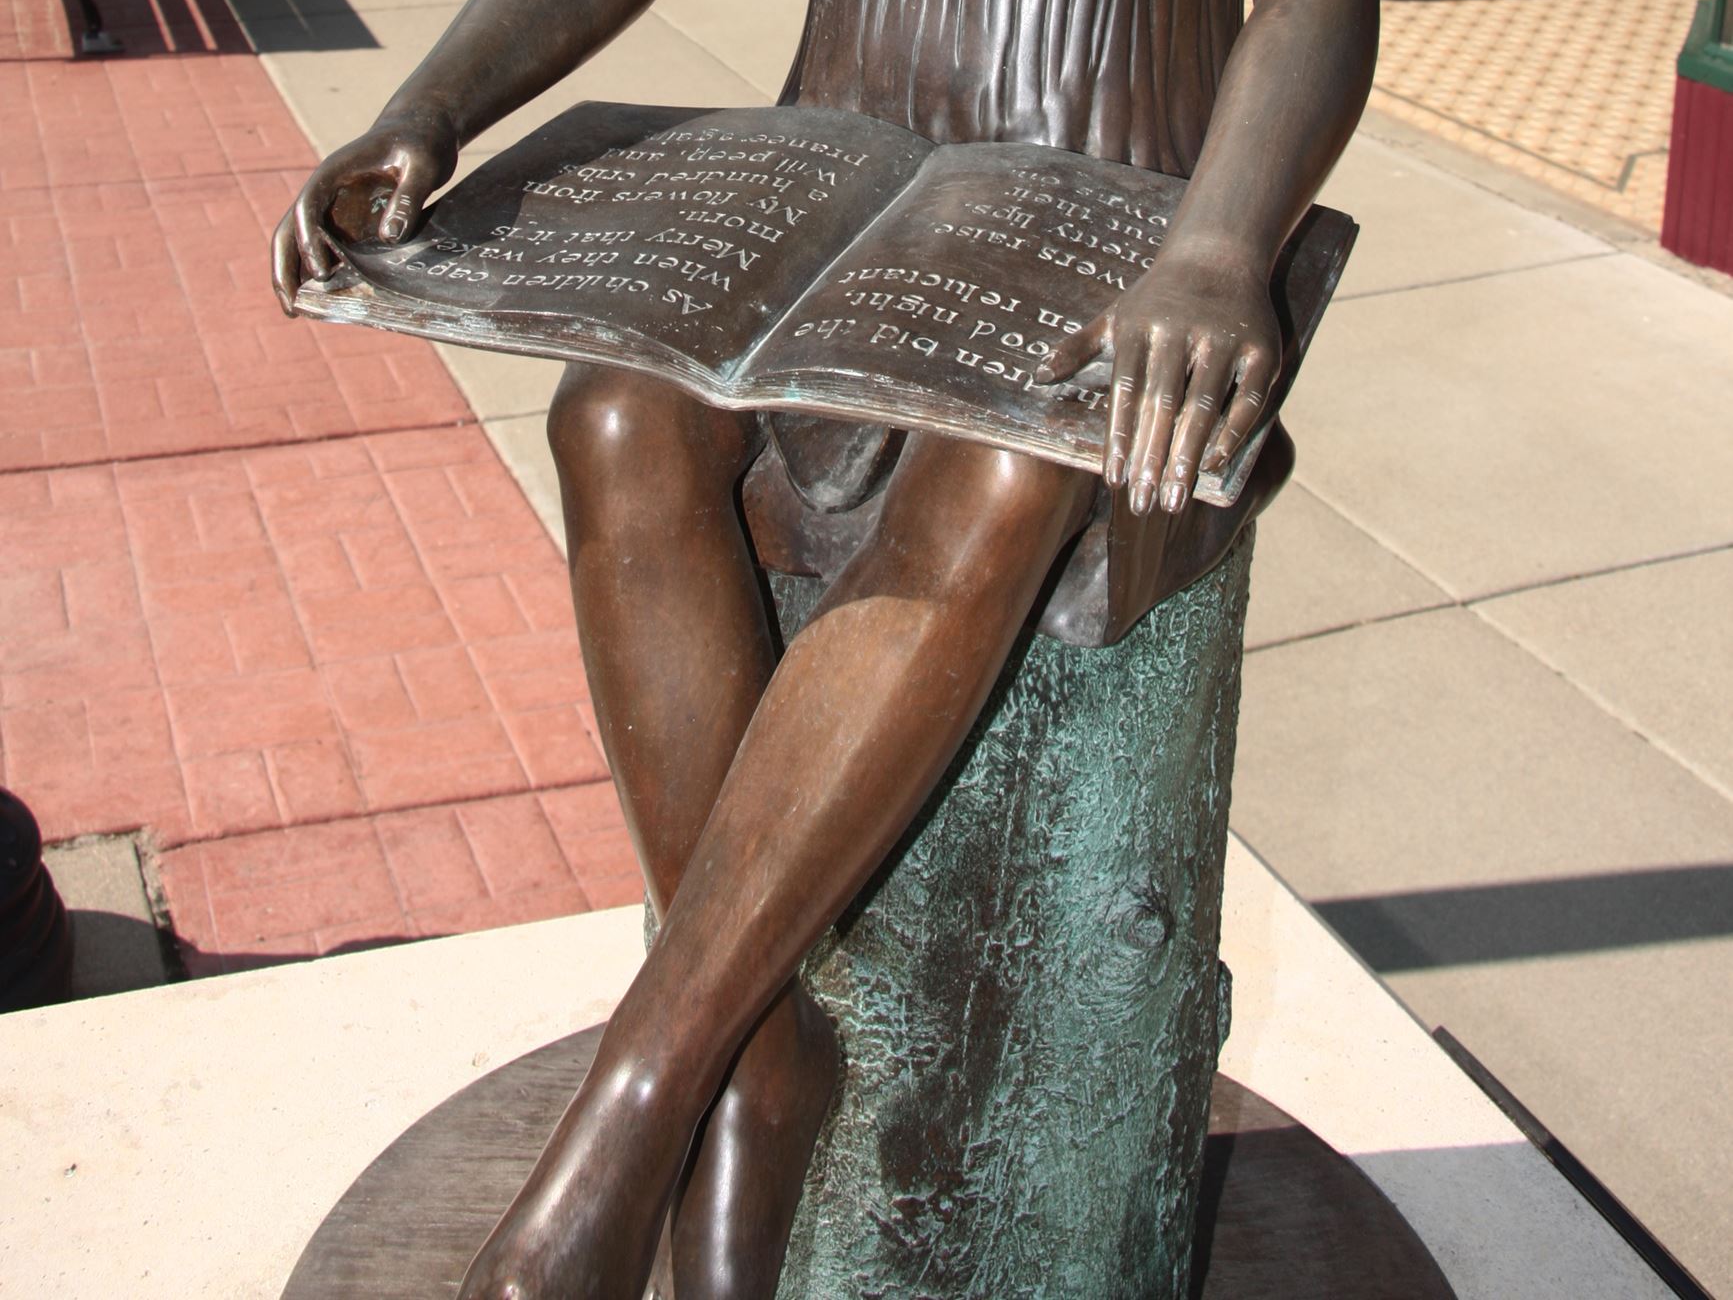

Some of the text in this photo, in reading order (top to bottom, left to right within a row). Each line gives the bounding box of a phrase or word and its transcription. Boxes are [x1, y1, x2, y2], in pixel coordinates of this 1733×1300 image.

[598, 147, 665, 164] and
[680, 147, 776, 162] peep,
[644, 171, 795, 193] hundred
[808, 187, 829, 202] a
[522, 180, 807, 226] My flowers from
[965, 202, 1035, 229] lips.
[1004, 186, 1092, 222] their
[678, 209, 784, 243] morn.
[489, 225, 760, 271] Merry that it is
[536, 250, 619, 267] they
[384, 255, 714, 316] As children caper
[634, 252, 731, 292] when
[1037, 246, 1125, 290] wers
[838, 268, 1082, 334] en reluctant
[844, 290, 1056, 364] ood night,
[794, 318, 1108, 409] hildren bid the
